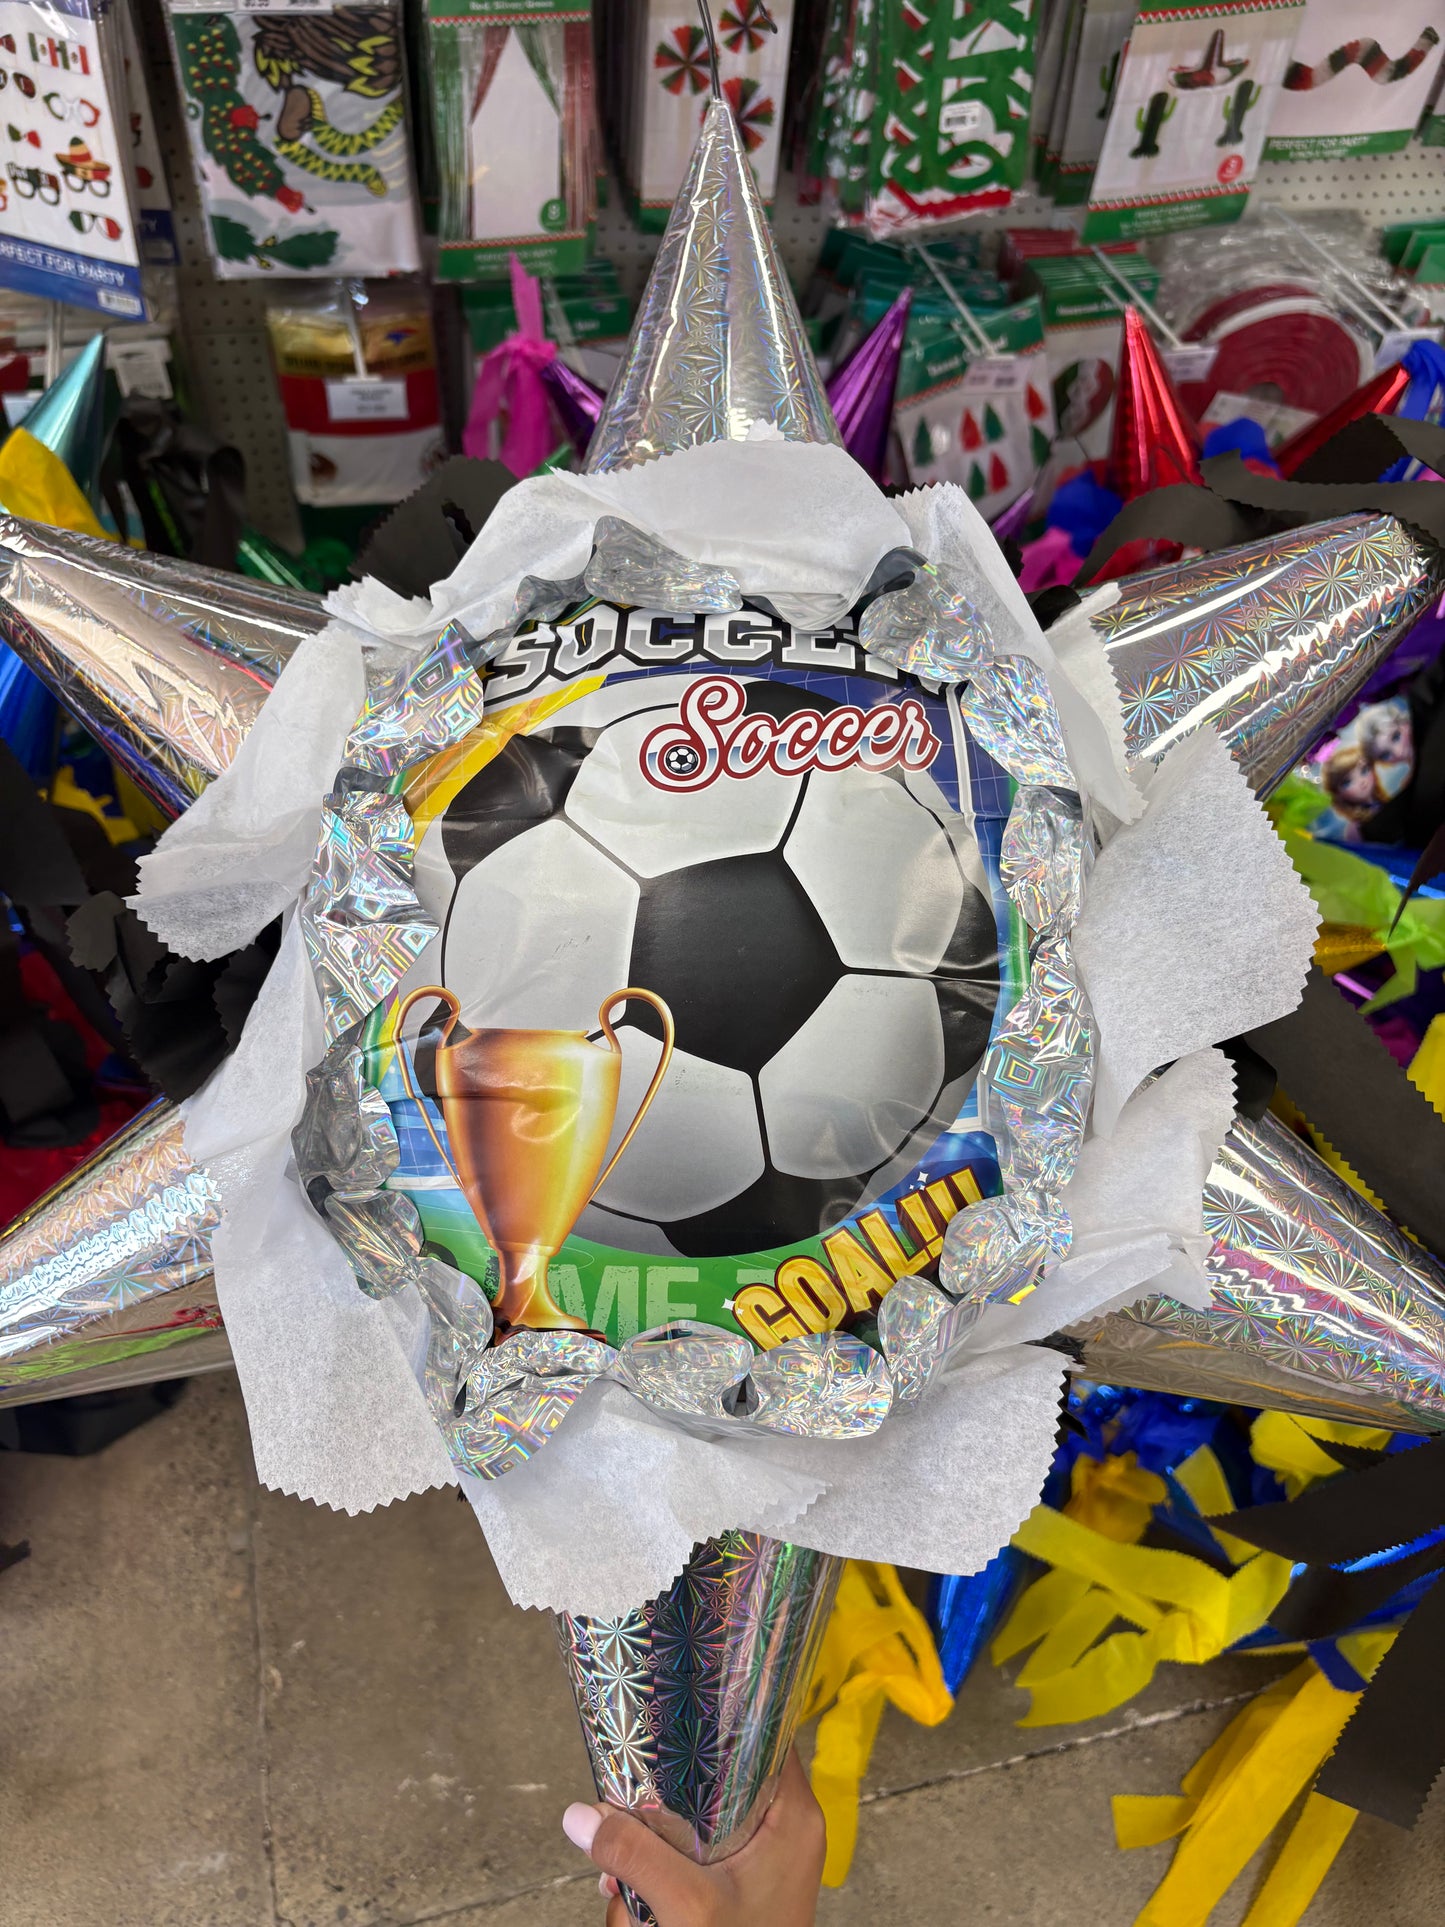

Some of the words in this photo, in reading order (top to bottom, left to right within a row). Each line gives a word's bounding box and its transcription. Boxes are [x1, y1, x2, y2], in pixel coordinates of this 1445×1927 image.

[78, 260, 125, 287] PARTY
[482, 604, 942, 699] SOCCE
[639, 674, 941, 793] Soccer
[732, 1164, 985, 1352] GOAL!!!
[546, 1263, 700, 1350] ME
